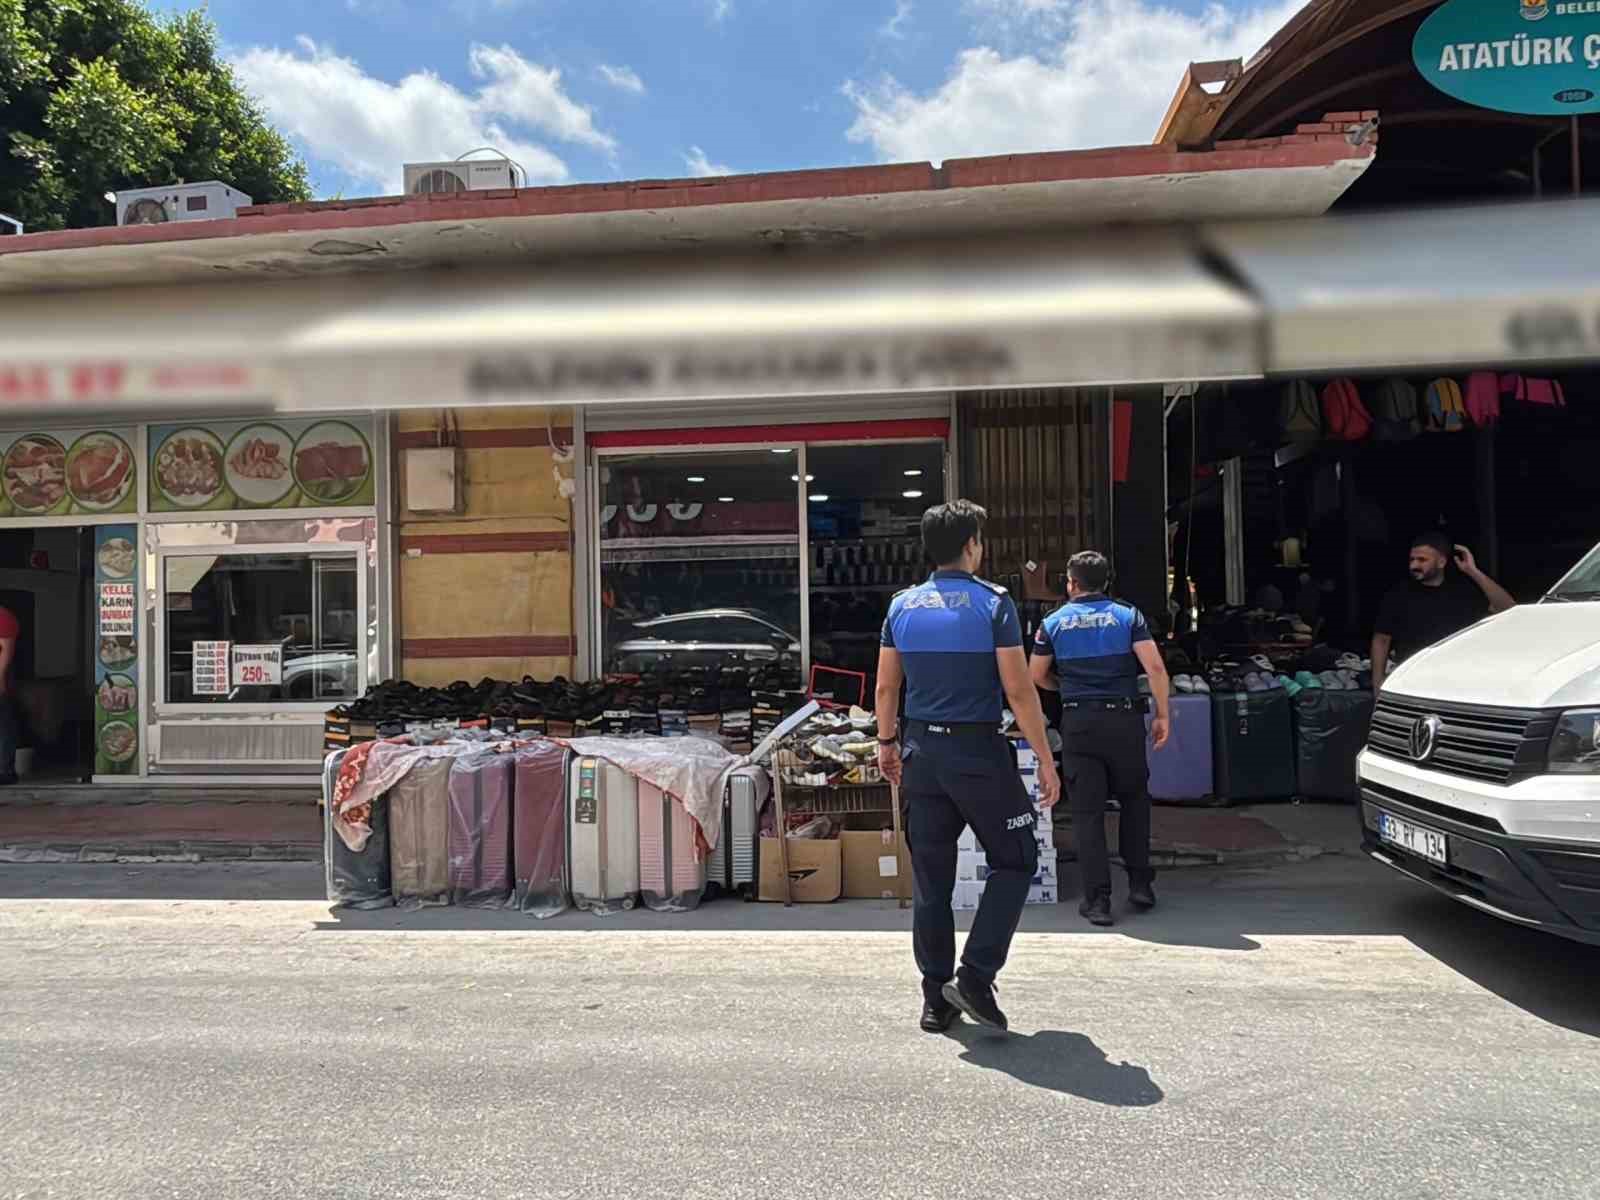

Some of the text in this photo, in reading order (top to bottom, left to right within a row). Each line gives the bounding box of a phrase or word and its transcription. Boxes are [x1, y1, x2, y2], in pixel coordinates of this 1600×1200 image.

[1438, 33, 1574, 71] ATATÜRK
[103, 585, 133, 595] KELLE
[101, 598, 133, 607] KARIN
[242, 666, 262, 682] 250
[1007, 812, 1034, 830] ZABITA
[1424, 831, 1445, 861] 134
